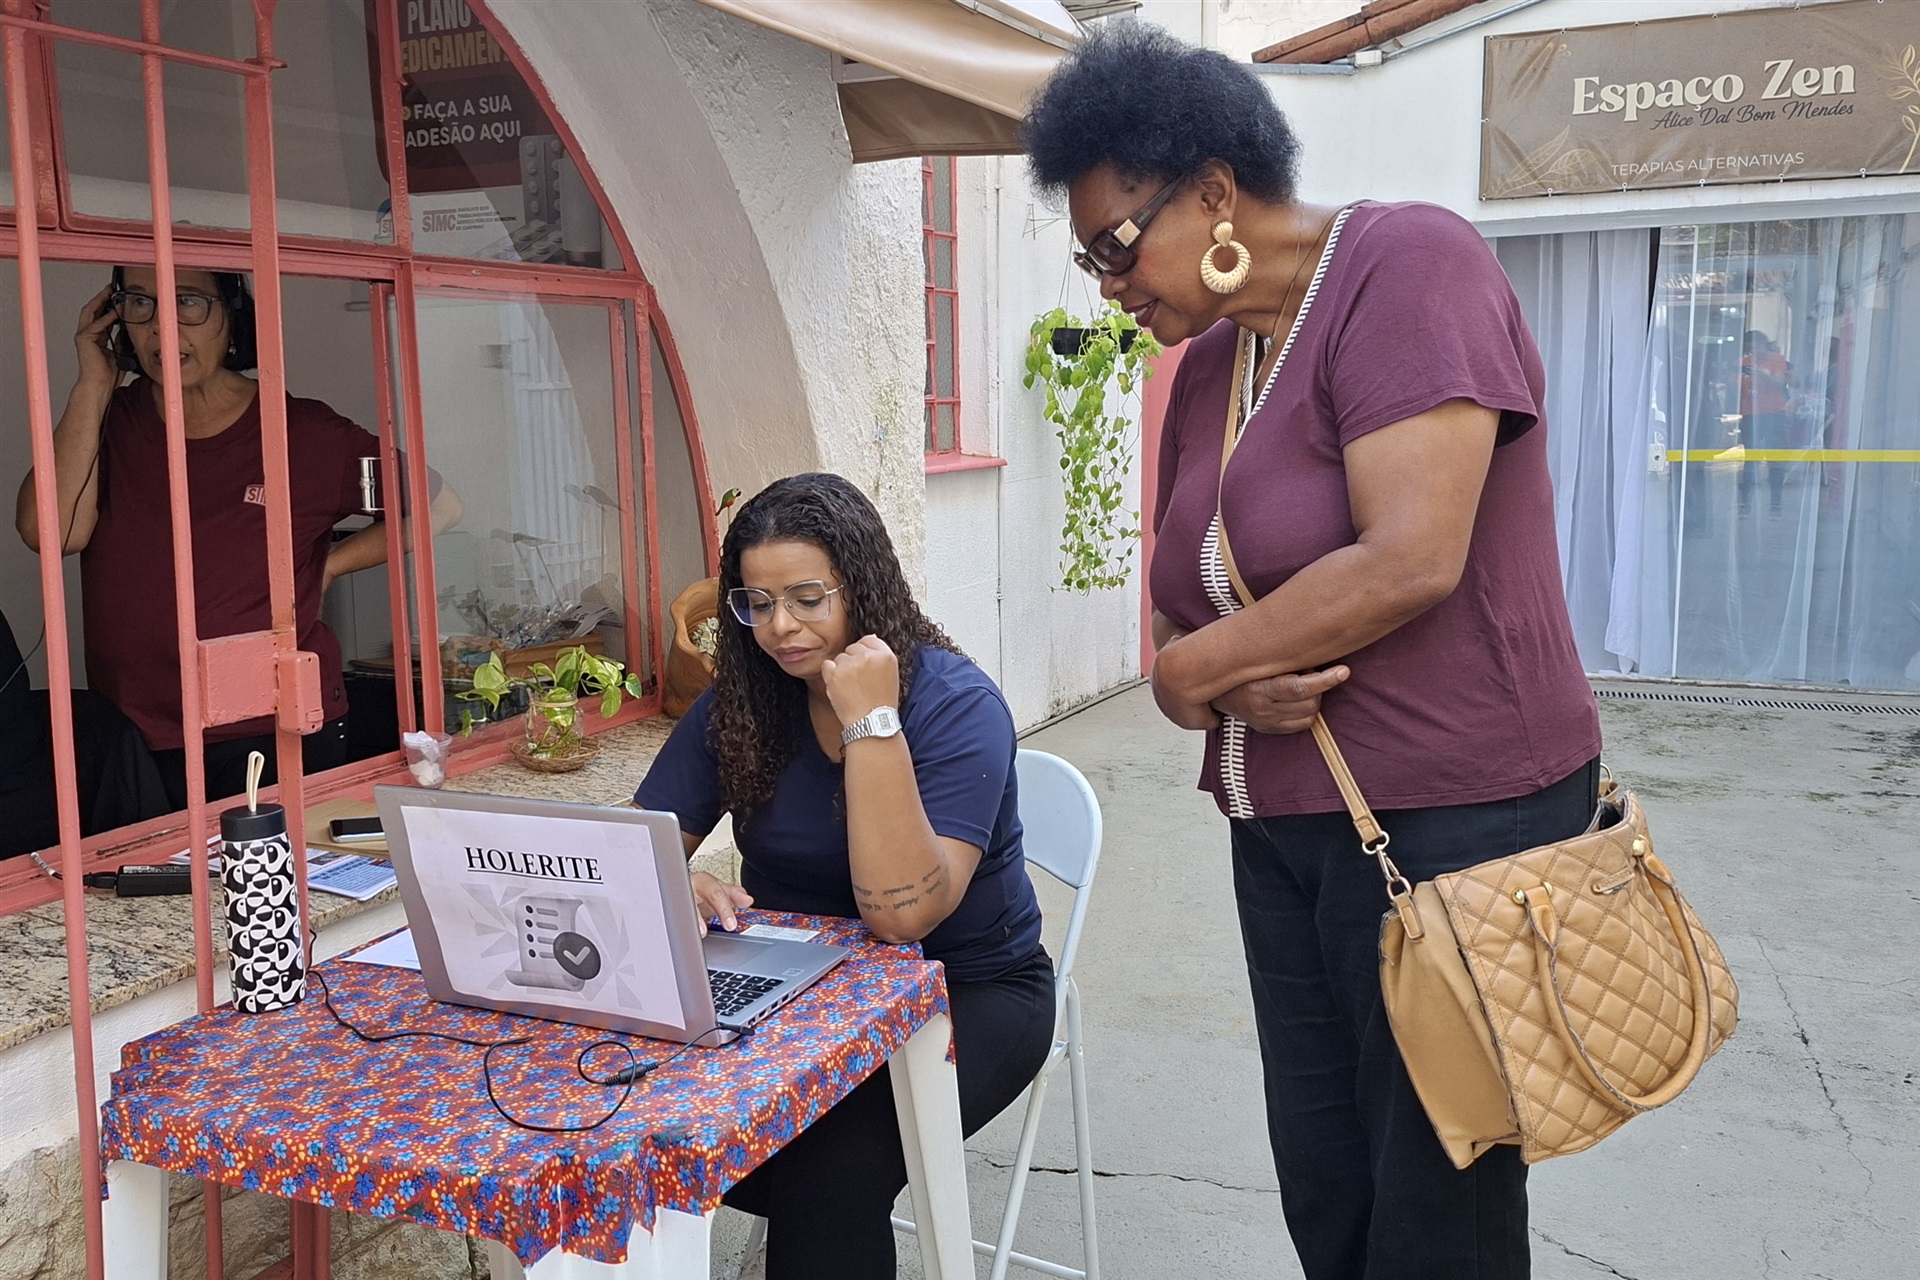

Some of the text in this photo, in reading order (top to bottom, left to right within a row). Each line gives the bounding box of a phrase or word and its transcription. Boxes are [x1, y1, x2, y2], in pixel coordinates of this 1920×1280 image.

[407, 0, 472, 35] PLANO
[400, 30, 511, 74] EDICAMEN
[1572, 59, 1856, 122] Espaço Zen
[413, 94, 512, 122] FAÇA A SUA
[1649, 99, 1855, 131] Alice Dal Bom Mendes
[405, 119, 521, 148] ADESÃO AQUI
[1611, 152, 1805, 176] TERAPIAS ALTERNATIVAS
[422, 209, 457, 233] STMC
[464, 847, 602, 881] HOLERITE
